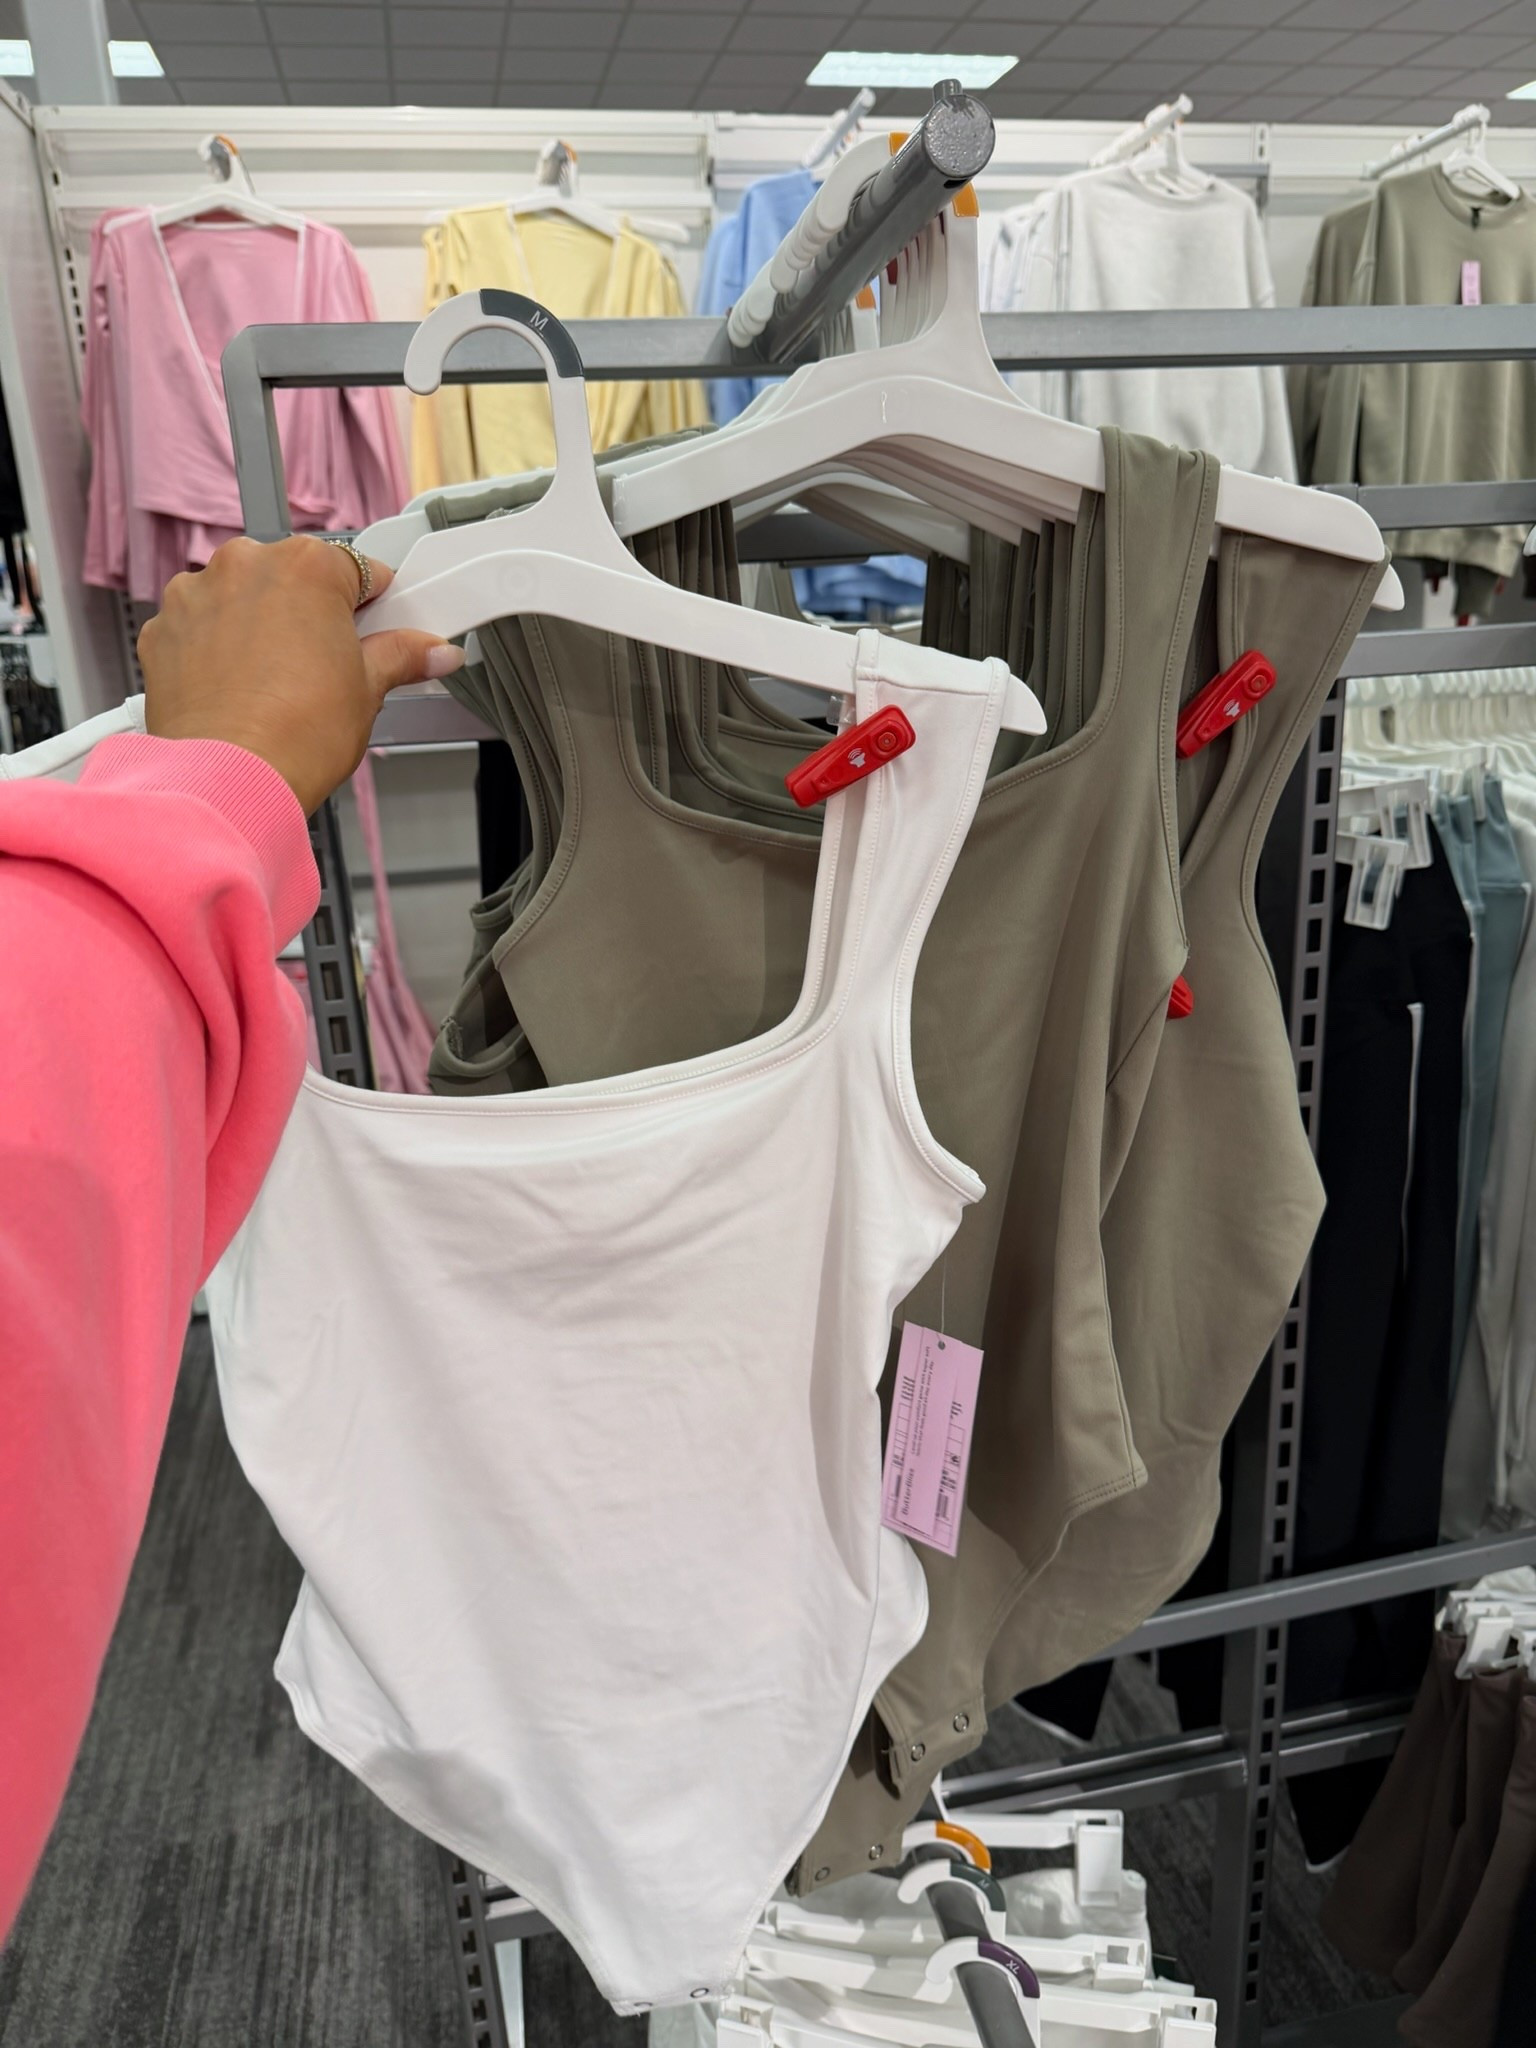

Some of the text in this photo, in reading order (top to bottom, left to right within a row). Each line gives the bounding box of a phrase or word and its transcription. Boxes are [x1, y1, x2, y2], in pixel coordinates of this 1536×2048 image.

[530, 310, 548, 330] M
[978, 1879, 989, 1889] M
[1006, 1959, 1021, 1975] XL
